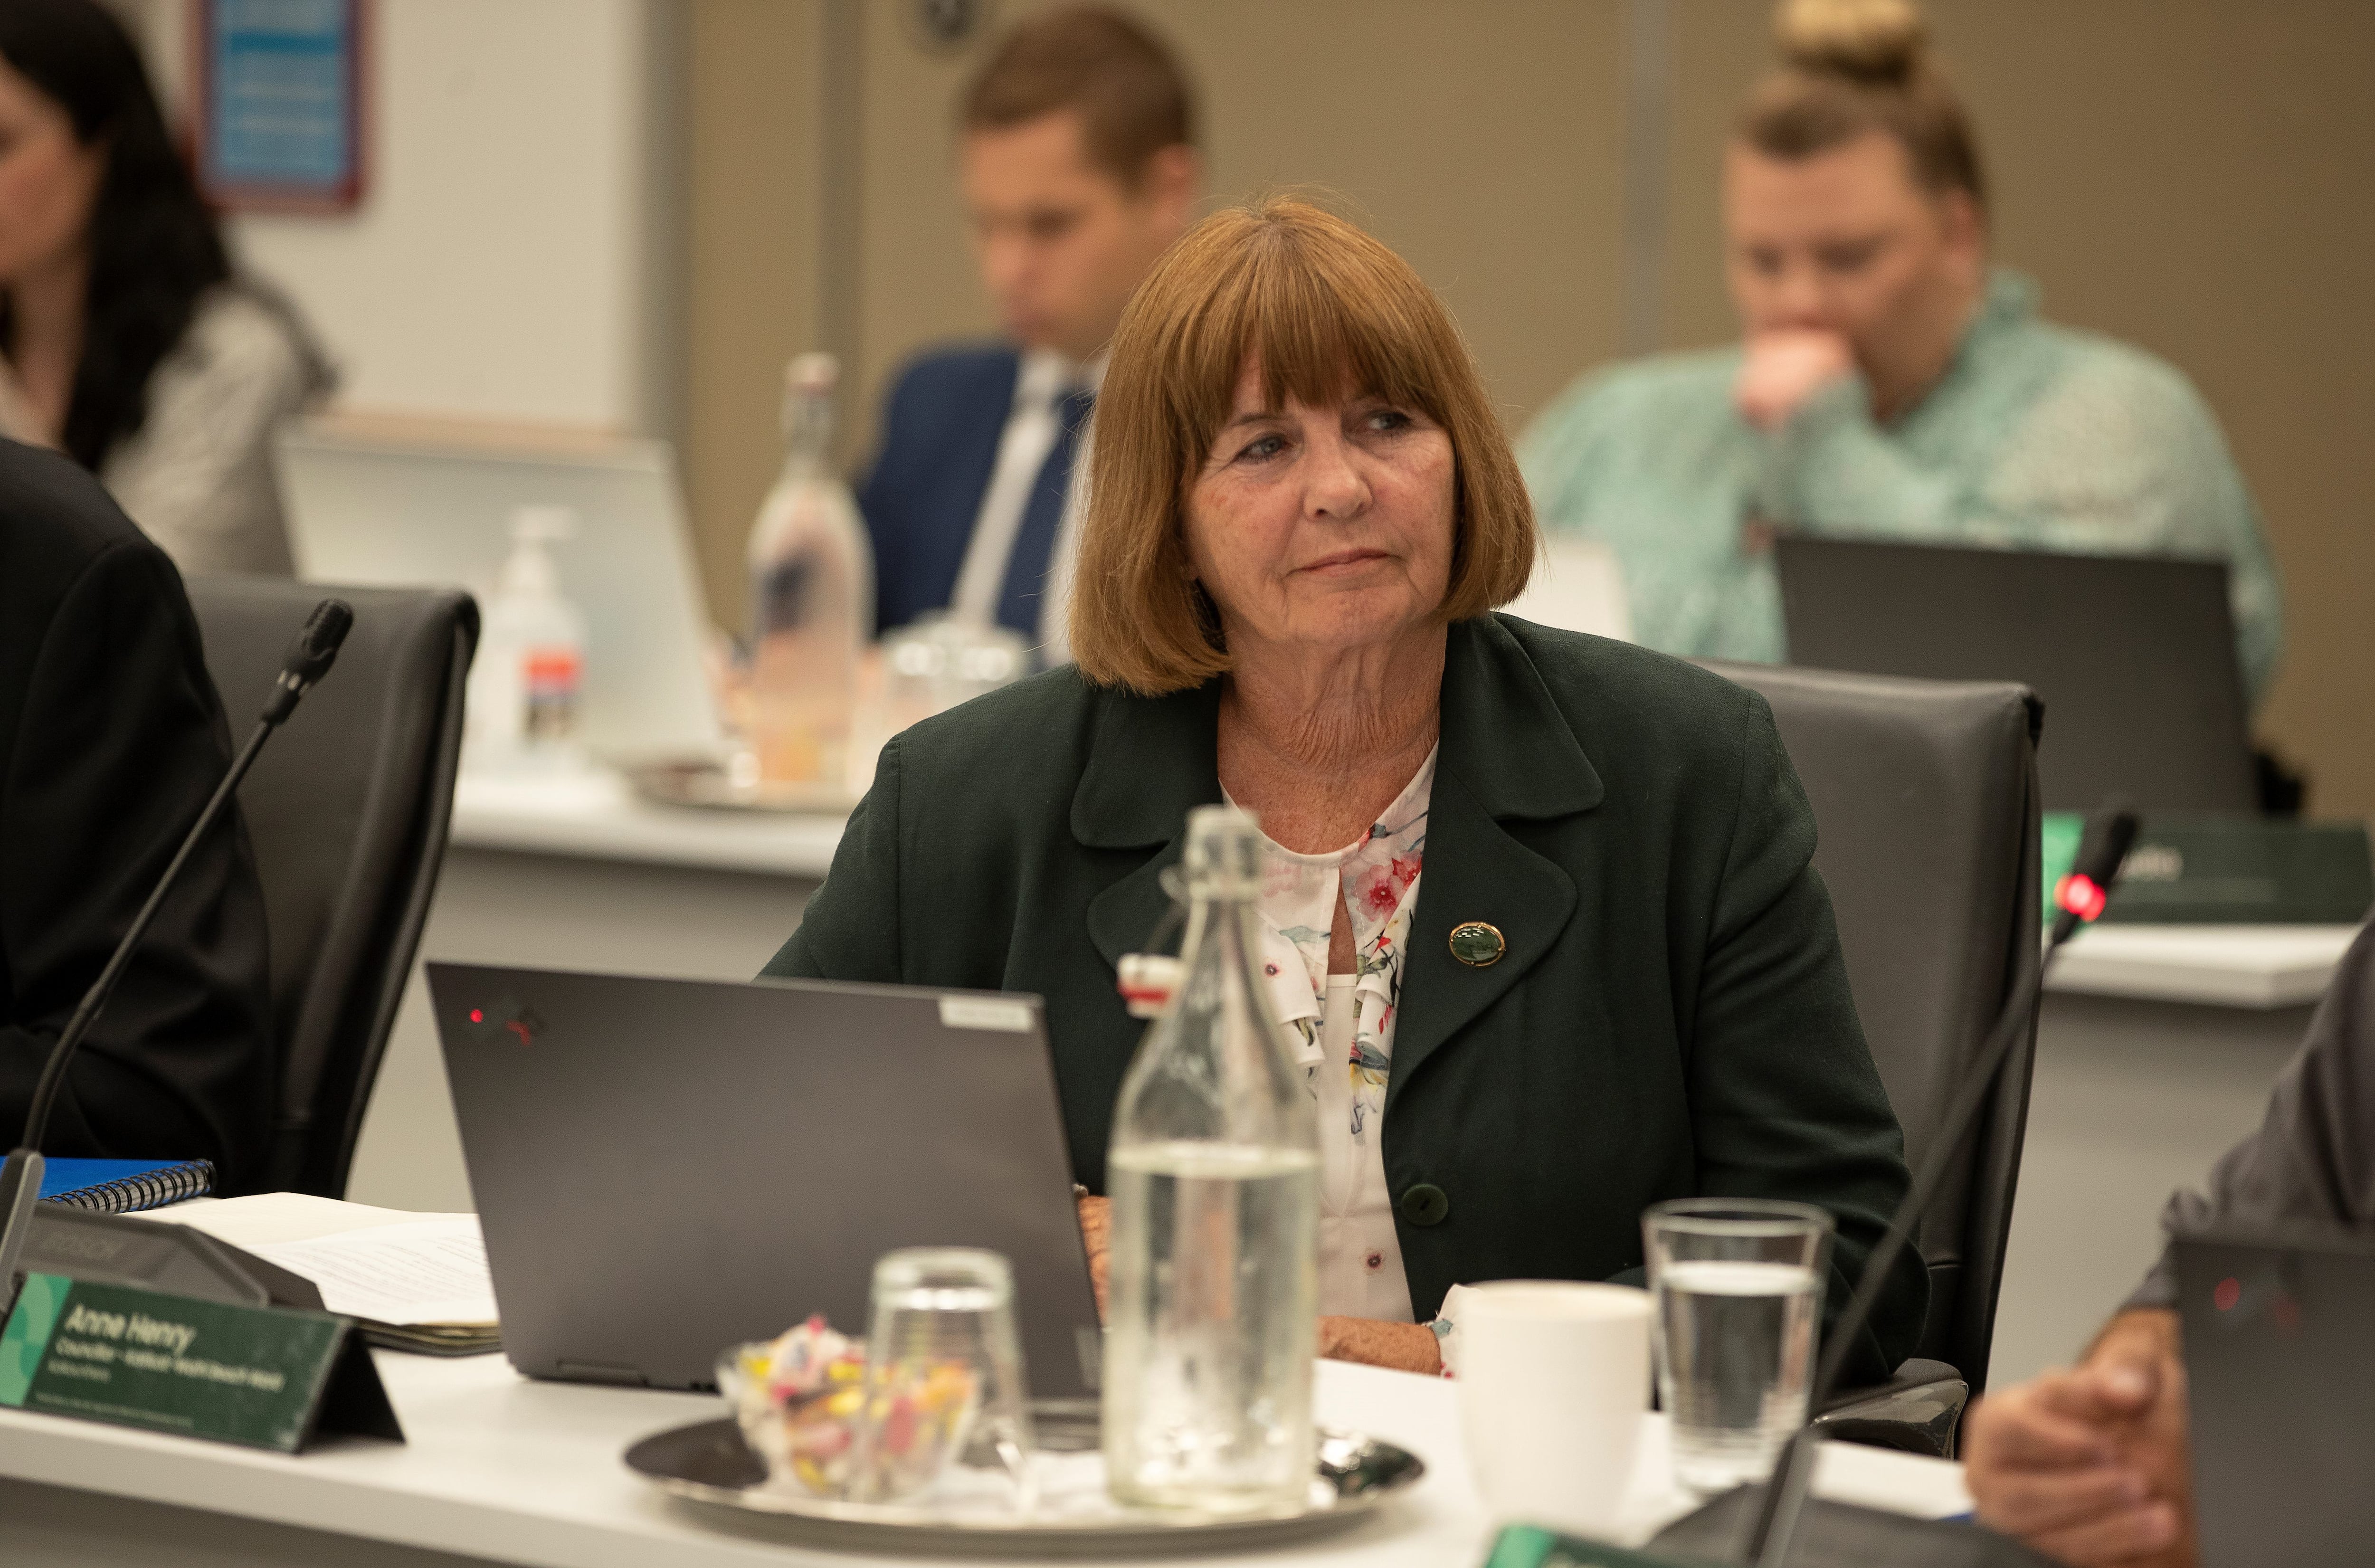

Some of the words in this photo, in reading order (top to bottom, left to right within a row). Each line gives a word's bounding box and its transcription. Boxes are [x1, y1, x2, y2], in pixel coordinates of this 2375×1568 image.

[40, 1232, 124, 1260] BOSCH
[65, 1304, 126, 1340] Anne
[125, 1311, 196, 1358] Henry
